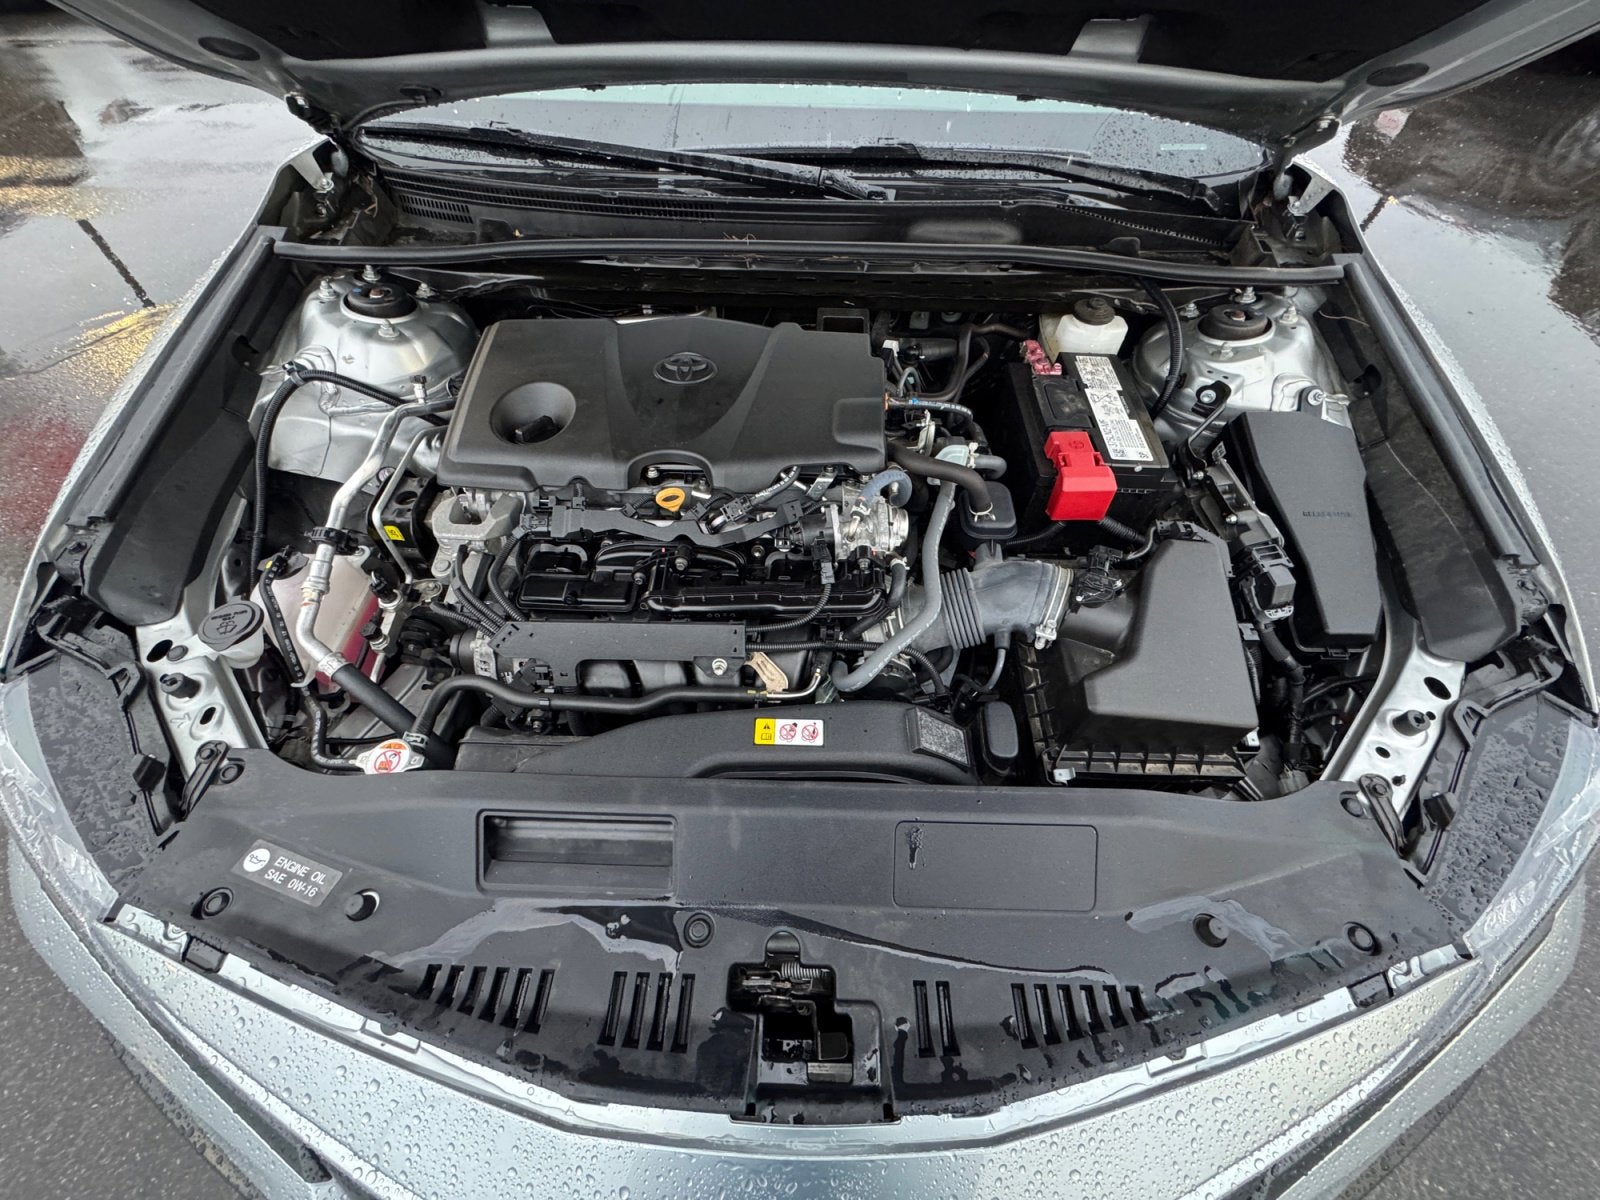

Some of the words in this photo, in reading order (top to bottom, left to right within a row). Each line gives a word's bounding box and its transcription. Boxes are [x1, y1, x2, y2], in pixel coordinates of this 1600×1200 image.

[264, 869, 288, 884] SAE
[287, 878, 318, 897] 0W-16
[274, 856, 311, 877] ENGINE
[310, 871, 327, 885] OIL
